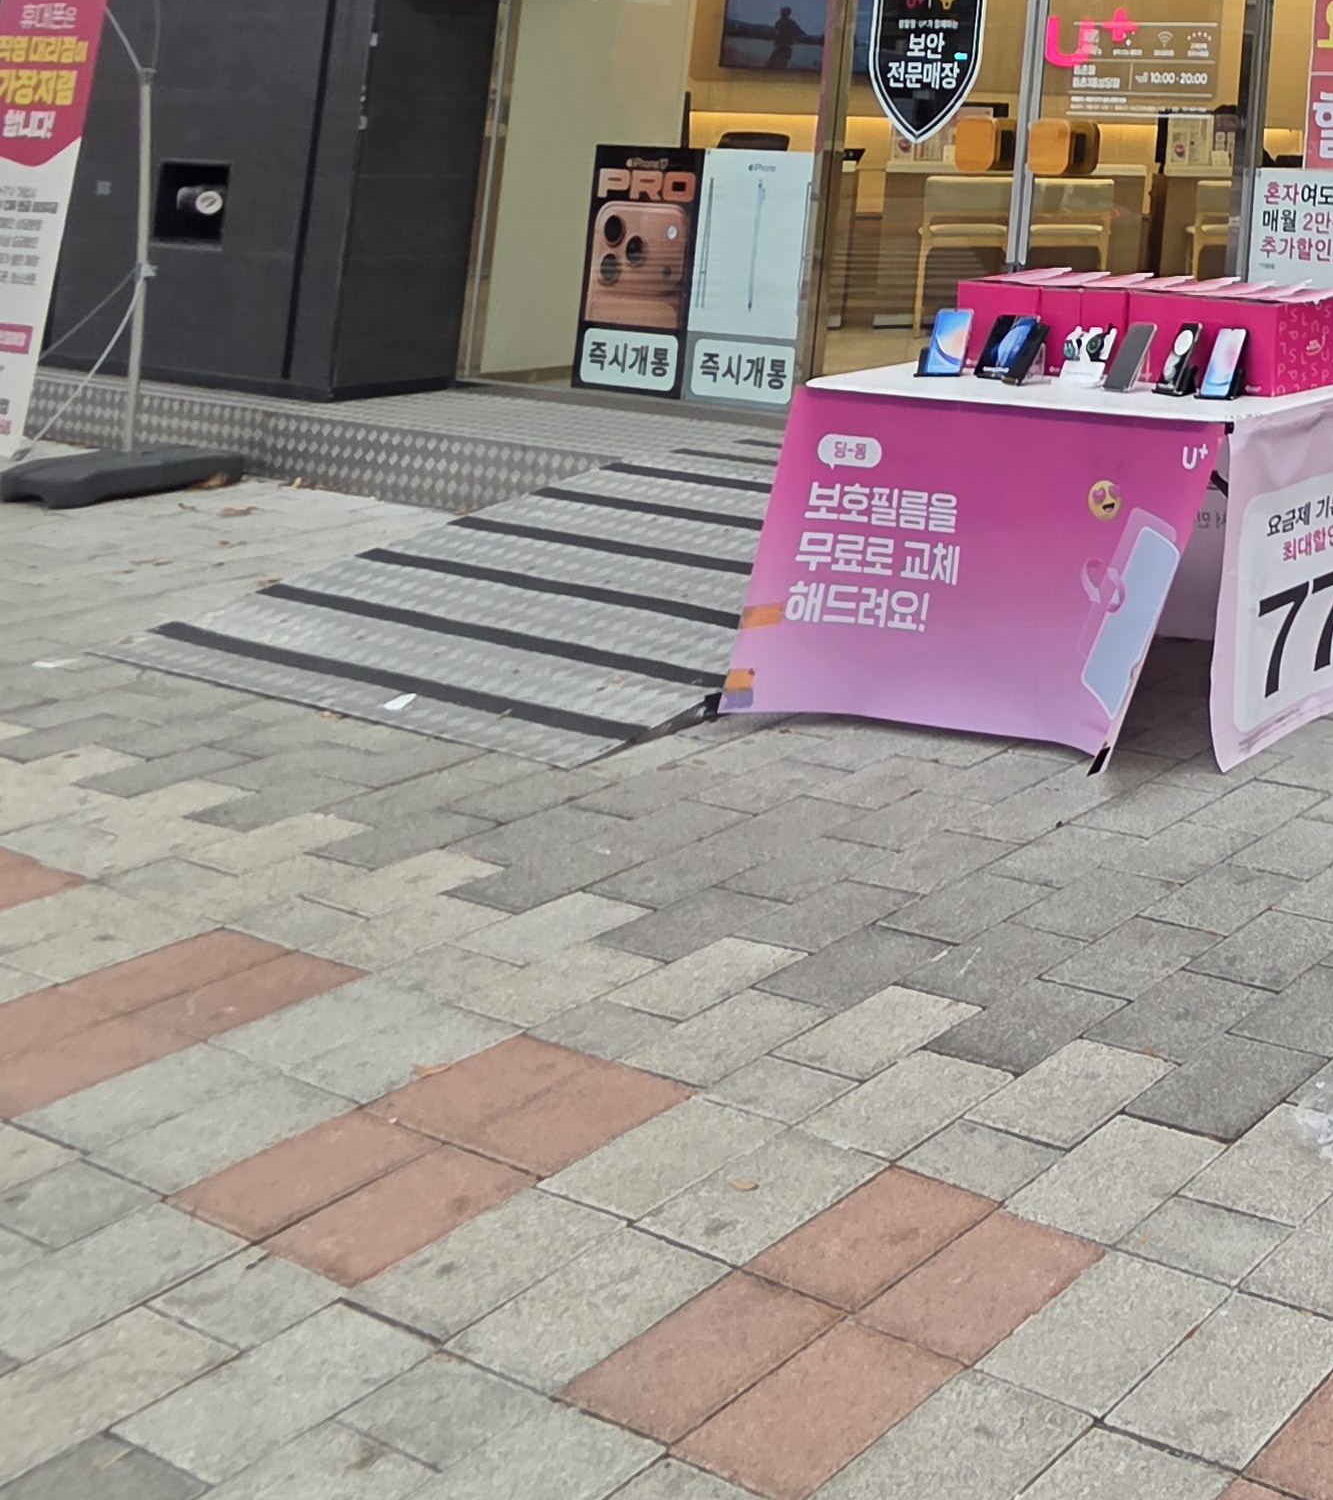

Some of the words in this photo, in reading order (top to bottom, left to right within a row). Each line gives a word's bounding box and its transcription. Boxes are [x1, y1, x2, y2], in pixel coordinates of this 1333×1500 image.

[907, 32, 945, 59] 보안
[1045, 8, 1138, 67] U+
[887, 61, 960, 89] 전문매장
[597, 168, 696, 202] PRO
[1262, 209, 1297, 233] 매월
[588, 341, 670, 378] 즉시개통
[700, 352, 788, 390] 즉시개통
[1182, 444, 1208, 469] U+
[804, 482, 957, 533] 보호필름을
[1267, 502, 1311, 537] 요금제
[795, 531, 894, 576] 무료로
[900, 541, 960, 585] 교체
[785, 580, 930, 632] 해드려요!
